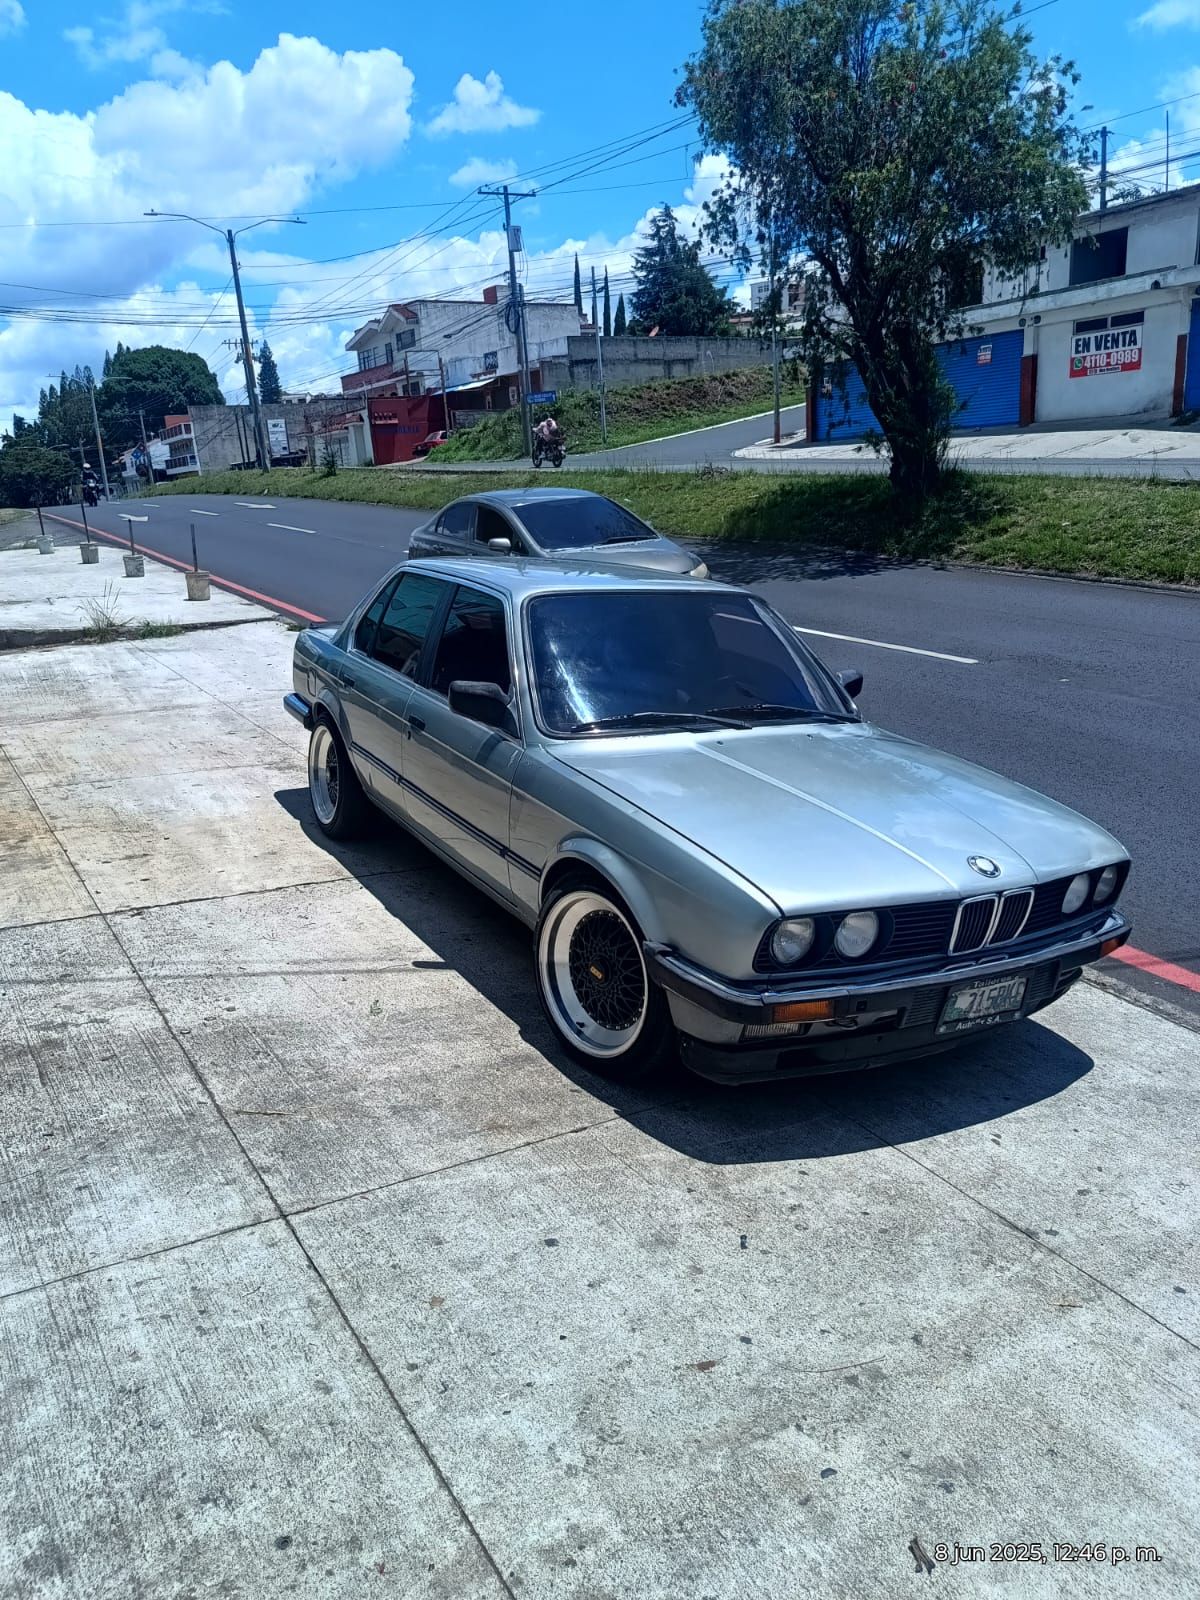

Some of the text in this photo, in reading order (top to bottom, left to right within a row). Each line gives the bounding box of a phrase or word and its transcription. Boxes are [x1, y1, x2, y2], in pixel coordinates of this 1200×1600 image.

[1075, 330, 1138, 355] EN VENTA
[1085, 349, 1139, 369] 4110-0989
